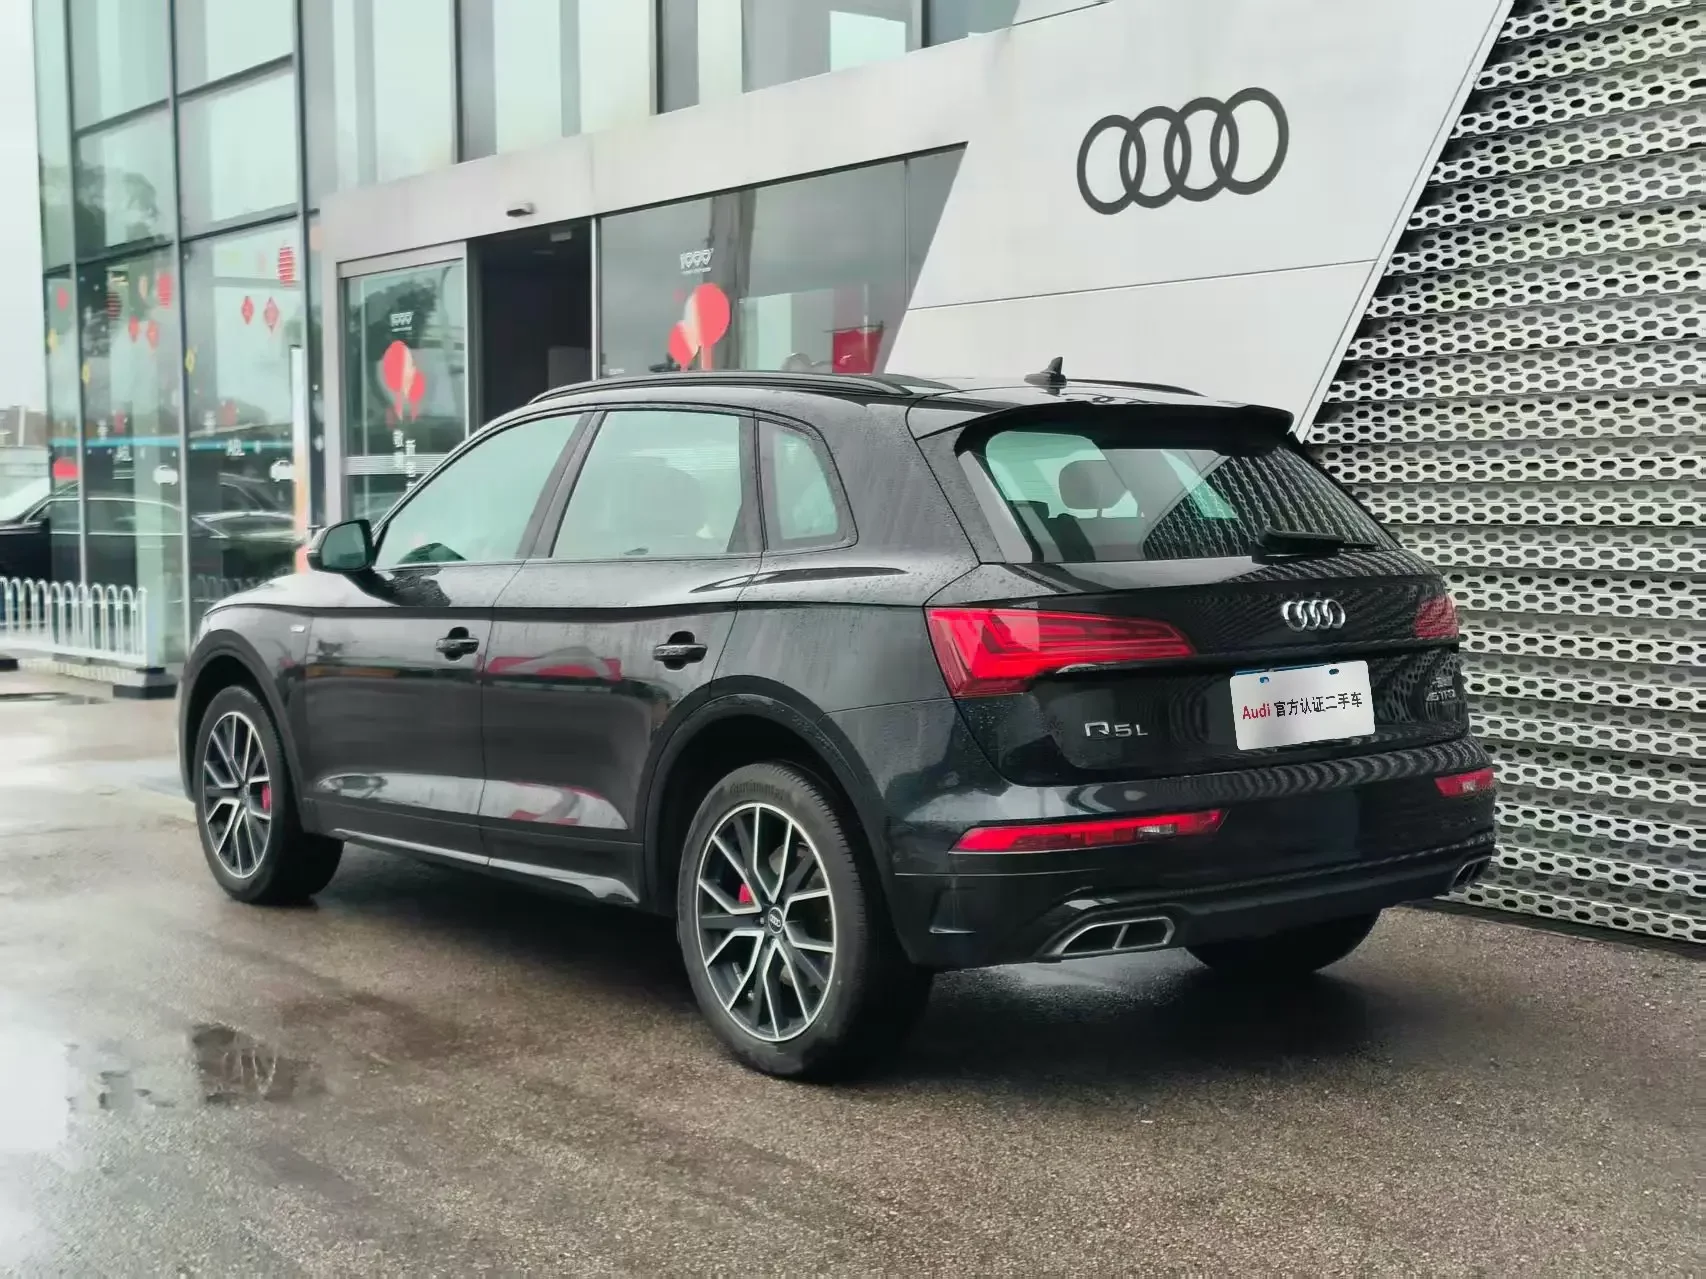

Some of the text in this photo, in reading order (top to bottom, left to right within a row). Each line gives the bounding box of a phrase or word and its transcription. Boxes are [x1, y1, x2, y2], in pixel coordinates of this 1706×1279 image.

[1242, 692, 1363, 720] Audi 官方认证二手车
